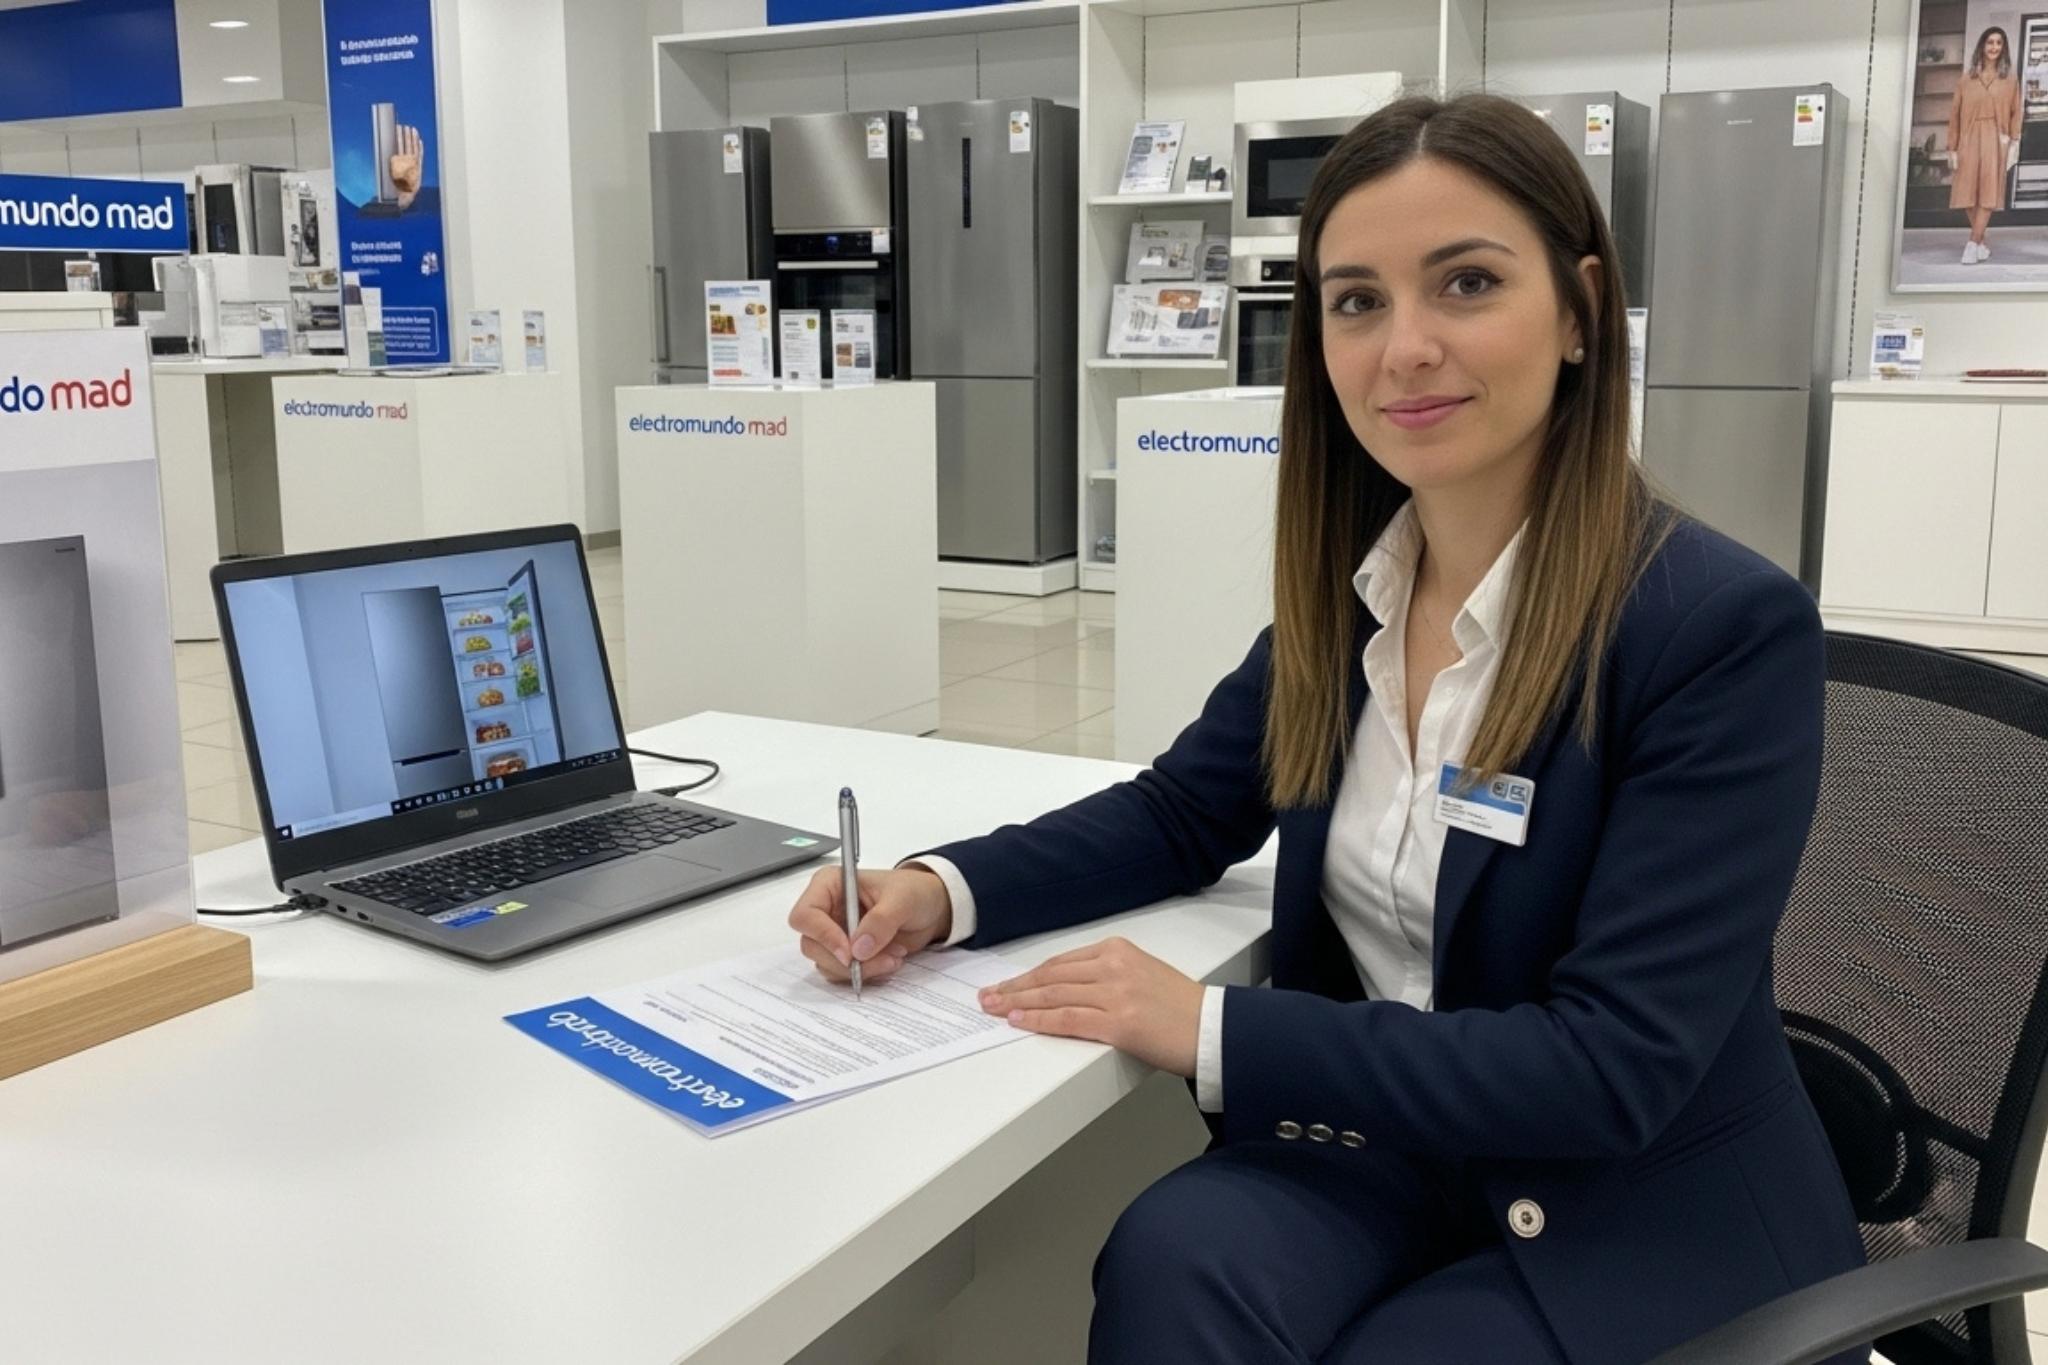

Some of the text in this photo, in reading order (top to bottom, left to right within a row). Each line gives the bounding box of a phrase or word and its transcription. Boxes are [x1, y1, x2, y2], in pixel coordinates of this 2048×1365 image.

[106, 196, 173, 230] mad
[51, 368, 132, 410] mad
[629, 414, 787, 436] electromundo mad
